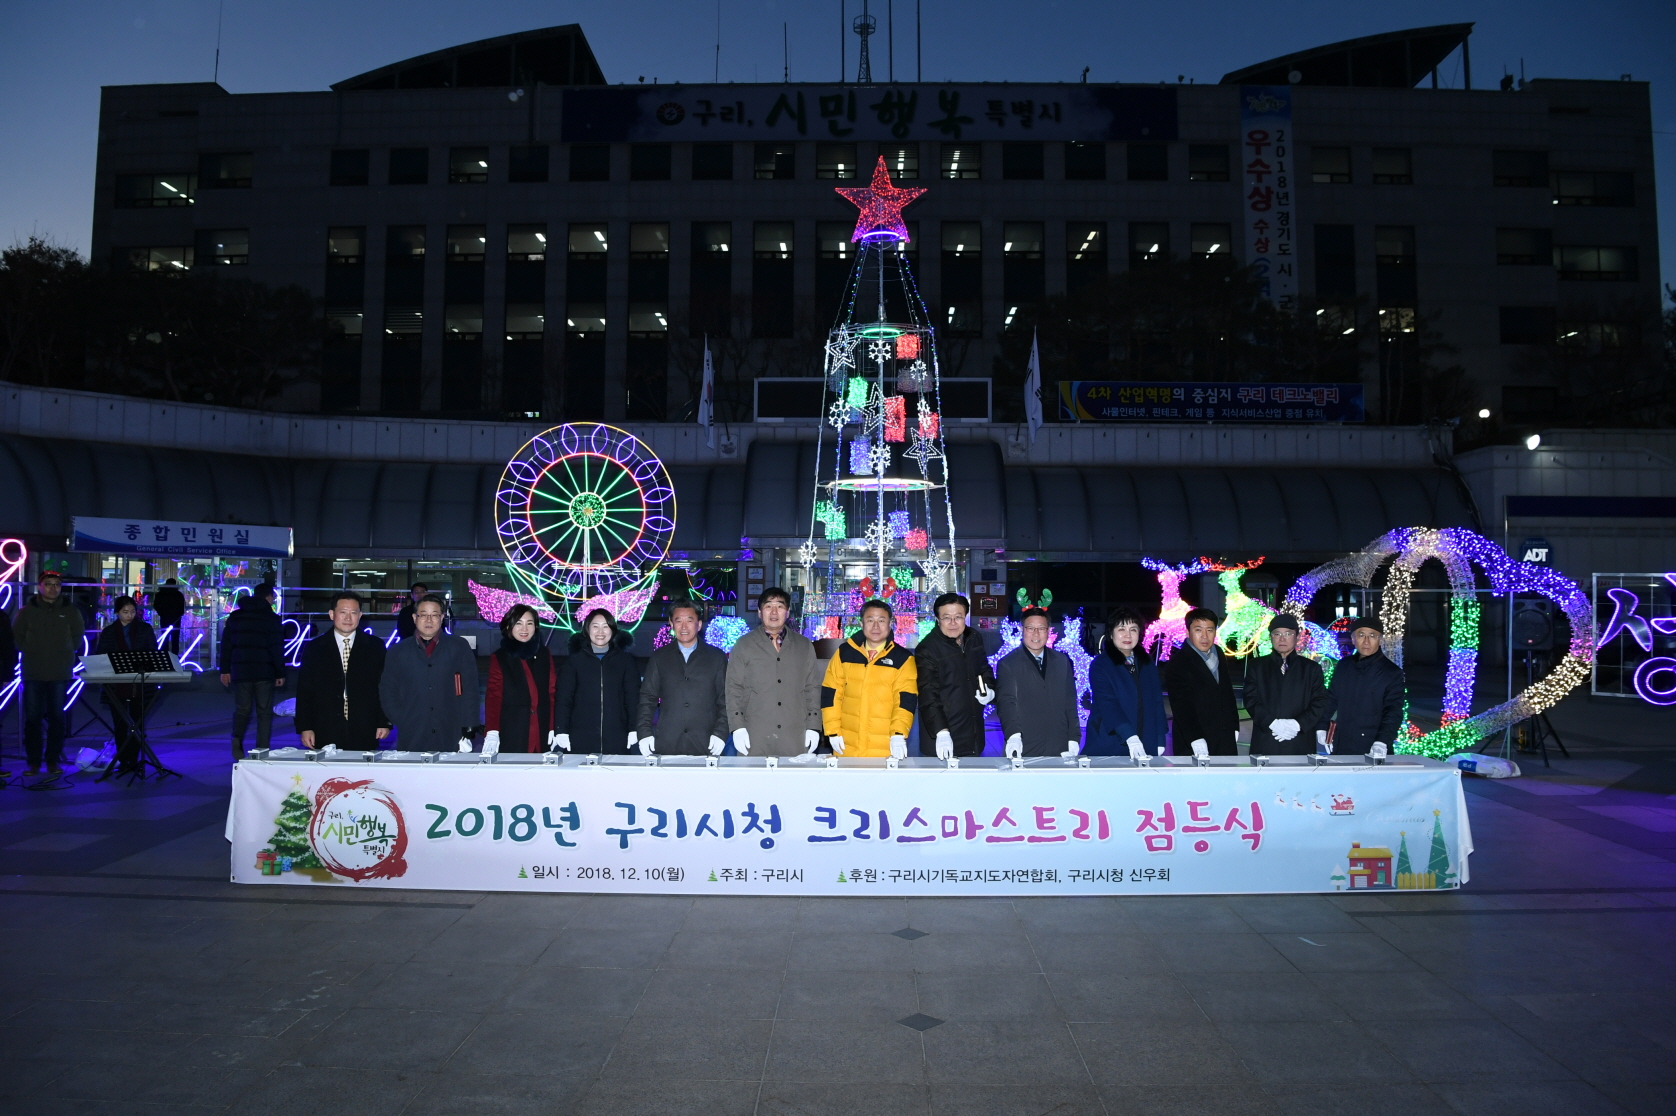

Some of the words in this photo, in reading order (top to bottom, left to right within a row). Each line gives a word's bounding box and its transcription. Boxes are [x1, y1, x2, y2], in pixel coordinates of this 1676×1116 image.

[985, 99, 1061, 128] 특별시
[1245, 129, 1275, 212] 우수상
[1253, 218, 1271, 254] 수상
[1277, 211, 1292, 256] 경기도
[1087, 386, 1112, 401] 4차
[1118, 386, 1185, 404] 산업혁명의
[1191, 386, 1232, 405] 중심지
[1237, 386, 1266, 404] 구리
[1185, 407, 1203, 418] 게임
[1285, 408, 1303, 419] 중점
[1306, 408, 1324, 419] 유치
[123, 524, 250, 545] 종합민원실
[136, 545, 165, 553] General
[167, 546, 184, 554] Civil
[1523, 548, 1549, 562] ADT
[425, 801, 581, 847] 2018년
[605, 801, 782, 850] 구리시청
[807, 806, 1110, 844] 크리스마스트리
[1135, 800, 1264, 852] 점등식
[362, 844, 385, 856] 특별시
[532, 865, 559, 879] 일시
[577, 867, 615, 880] 2018.
[620, 867, 640, 881] 12.
[644, 866, 685, 882] 10(월)
[719, 868, 748, 882] 주최
[761, 868, 804, 883] 구리시
[849, 868, 877, 883] 후원
[888, 868, 1062, 883] 구리시기독교지도자연합회,
[1067, 868, 1124, 883] 구리시청
[1129, 868, 1170, 882] 신우회
